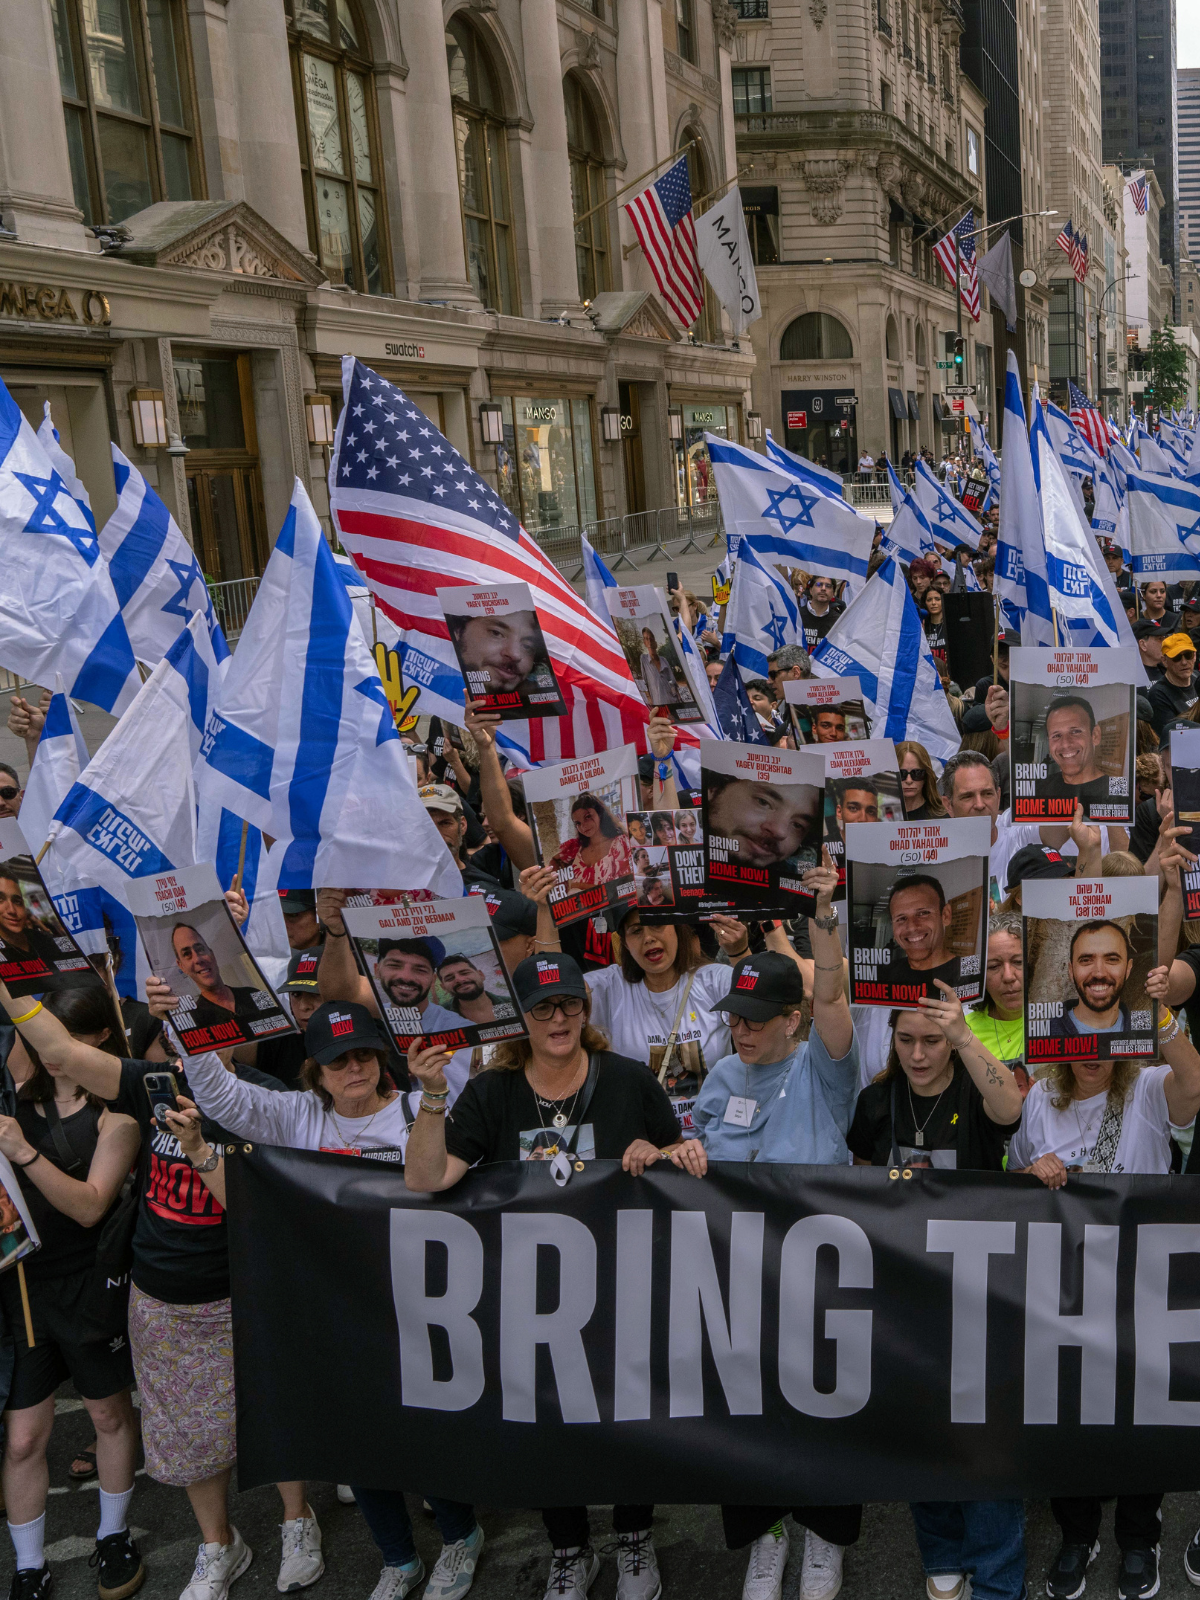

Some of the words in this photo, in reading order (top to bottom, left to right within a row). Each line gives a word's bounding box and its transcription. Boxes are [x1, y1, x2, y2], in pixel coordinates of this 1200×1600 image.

[0, 281, 78, 322] MEGA
[385, 342, 419, 357] swatch
[787, 374, 812, 382] HARRY
[526, 407, 557, 420] MANGO
[694, 412, 713, 422] MANGO
[963, 495, 980, 508] HELL
[1047, 664, 1065, 673] OHAD
[1066, 664, 1098, 673] YAHALOMI
[466, 671, 491, 682] BRING
[1056, 675, 1074, 685] (50)
[469, 683, 486, 694] HIM
[735, 760, 755, 771] YAGEV
[755, 762, 792, 775] BUCHSHTAB
[844, 758, 871, 767] ALEXANDER
[559, 773, 584, 787] DANIELA
[585, 767, 605, 781] GILBOA
[757, 771, 769, 781] (35)
[1015, 763, 1047, 779] BRING
[578, 780, 590, 791] (19)
[1015, 780, 1035, 796] HIM
[1016, 799, 1046, 815] HOME
[1048, 797, 1078, 815] NOW!
[1111, 809, 1128, 817] FORUM
[923, 826, 940, 837] אוהד
[709, 835, 739, 851] BRING
[890, 839, 910, 850] OHAD
[912, 837, 948, 849] YAHALOMI
[709, 849, 729, 862] HIM
[900, 851, 921, 863] (50)
[709, 862, 737, 878] HOME
[740, 867, 769, 883] NOW!
[155, 889, 173, 901] TSACHI
[173, 886, 186, 897] IDAN
[550, 884, 567, 903] HER
[552, 896, 575, 918] HOME
[576, 884, 608, 909] NOW!
[1069, 895, 1081, 905] TAL
[1083, 895, 1112, 905] SHOHAM
[162, 901, 176, 913] (50)
[379, 919, 395, 928] GALI
[397, 917, 411, 927] AND
[412, 916, 424, 925] ZIV
[425, 912, 455, 923] BERMAN
[412, 925, 428, 935] (26)
[854, 948, 890, 964] BRING
[1, 960, 21, 977] HOME
[22, 957, 49, 972] NOW!
[854, 965, 877, 981] HIM
[538, 969, 560, 982] NOW
[855, 982, 889, 999] HOME
[892, 982, 927, 1001] NOW!
[386, 1007, 421, 1022] BRING
[1028, 1002, 1063, 1019] BRING
[171, 1013, 196, 1031] HIM
[331, 1019, 353, 1034] NOW
[389, 1020, 423, 1035] THEM
[1028, 1020, 1050, 1037] HIM
[181, 1028, 211, 1049] HOME
[212, 1019, 241, 1043] NOW!
[1029, 1039, 1061, 1056] HOME
[1064, 1034, 1098, 1054] NOW!
[1110, 1046, 1134, 1054] FAMILIES
[1135, 1044, 1153, 1053] FORUM
[389, 1207, 873, 1424] BRING
